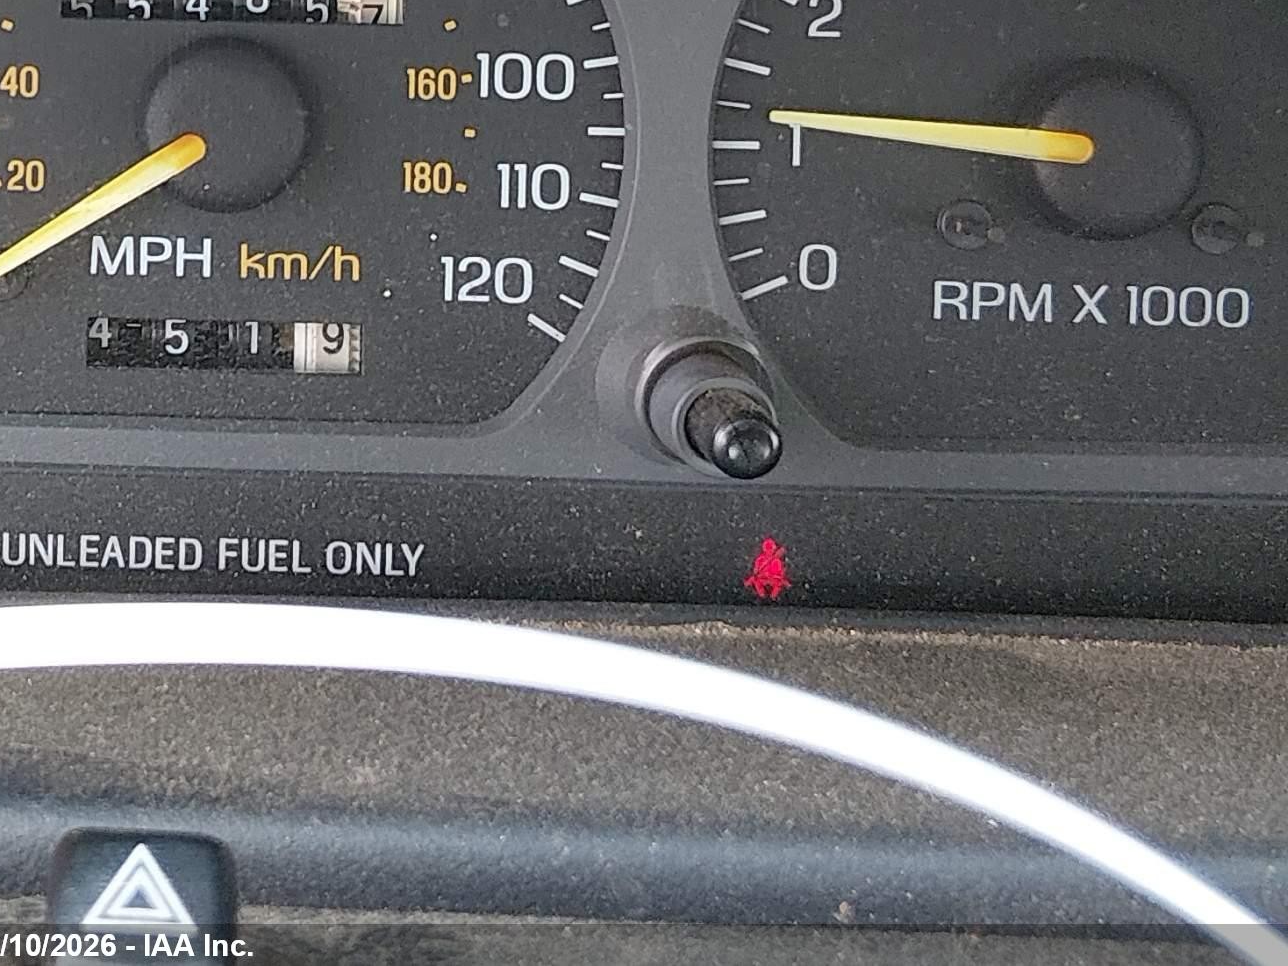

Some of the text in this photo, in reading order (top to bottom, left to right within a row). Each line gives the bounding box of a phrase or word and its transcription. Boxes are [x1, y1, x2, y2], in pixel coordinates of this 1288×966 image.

[0, 66, 38, 97] 40
[407, 69, 456, 100] 160
[477, 53, 574, 100] 100
[788, 123, 801, 167] 1
[7, 160, 44, 191] 20
[404, 162, 451, 193] 180
[498, 164, 569, 210] 110
[89, 235, 361, 282] MPH km/h
[441, 257, 532, 303] 120
[799, 244, 837, 290] 0
[934, 281, 1249, 327] RPM X 1000
[1, 532, 425, 577] UNLEADED FUEL ONLY
